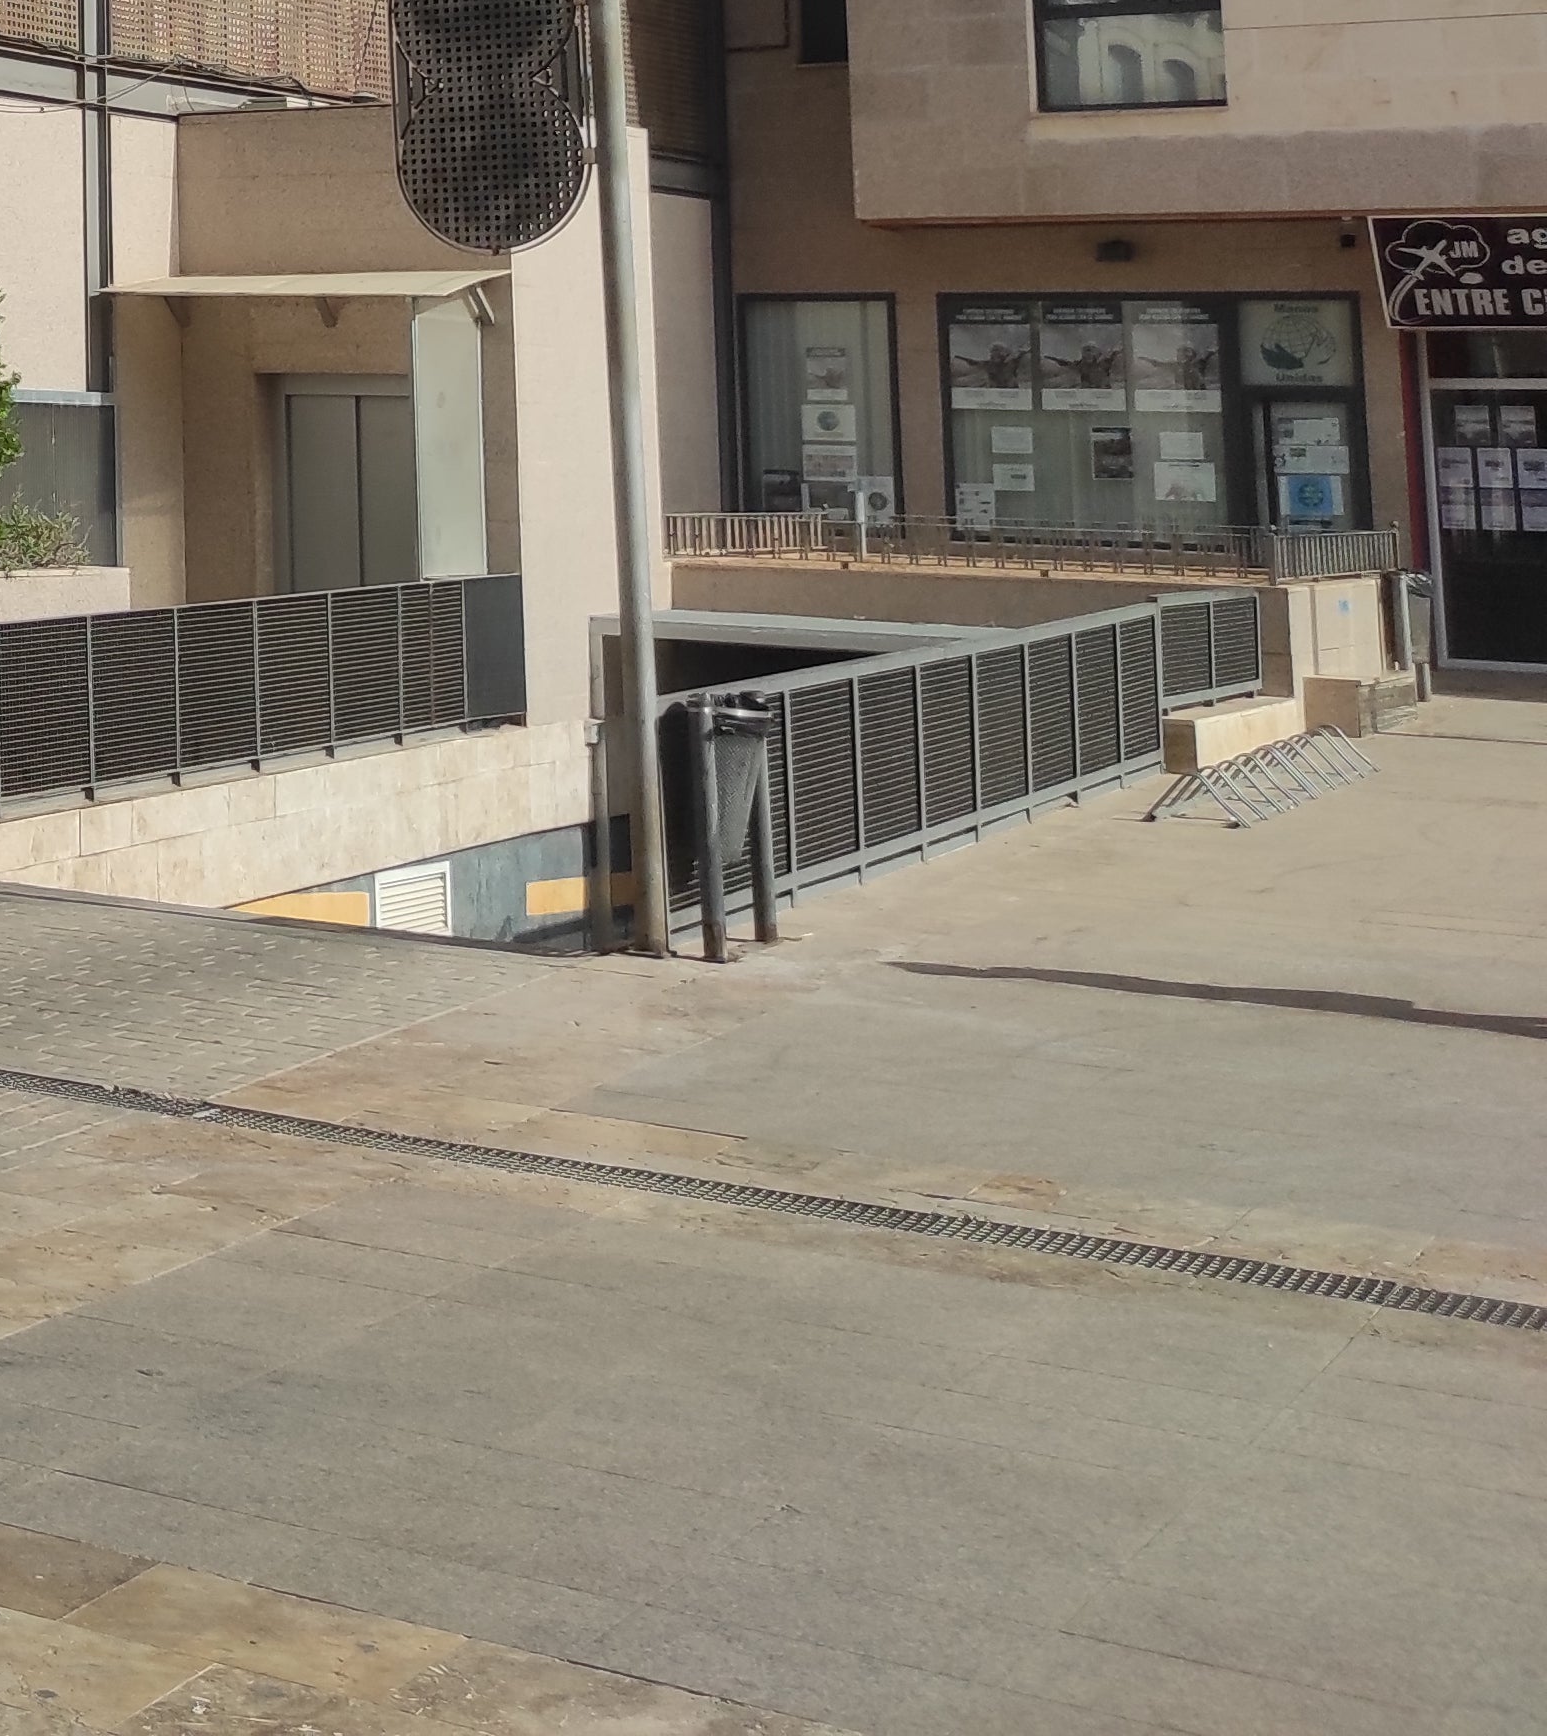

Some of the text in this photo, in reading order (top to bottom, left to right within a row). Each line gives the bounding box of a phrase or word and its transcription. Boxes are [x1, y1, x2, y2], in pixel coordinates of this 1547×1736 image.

[1448, 241, 1480, 259] JM
[1501, 255, 1547, 276] de
[1413, 288, 1547, 316] ENTRE C
